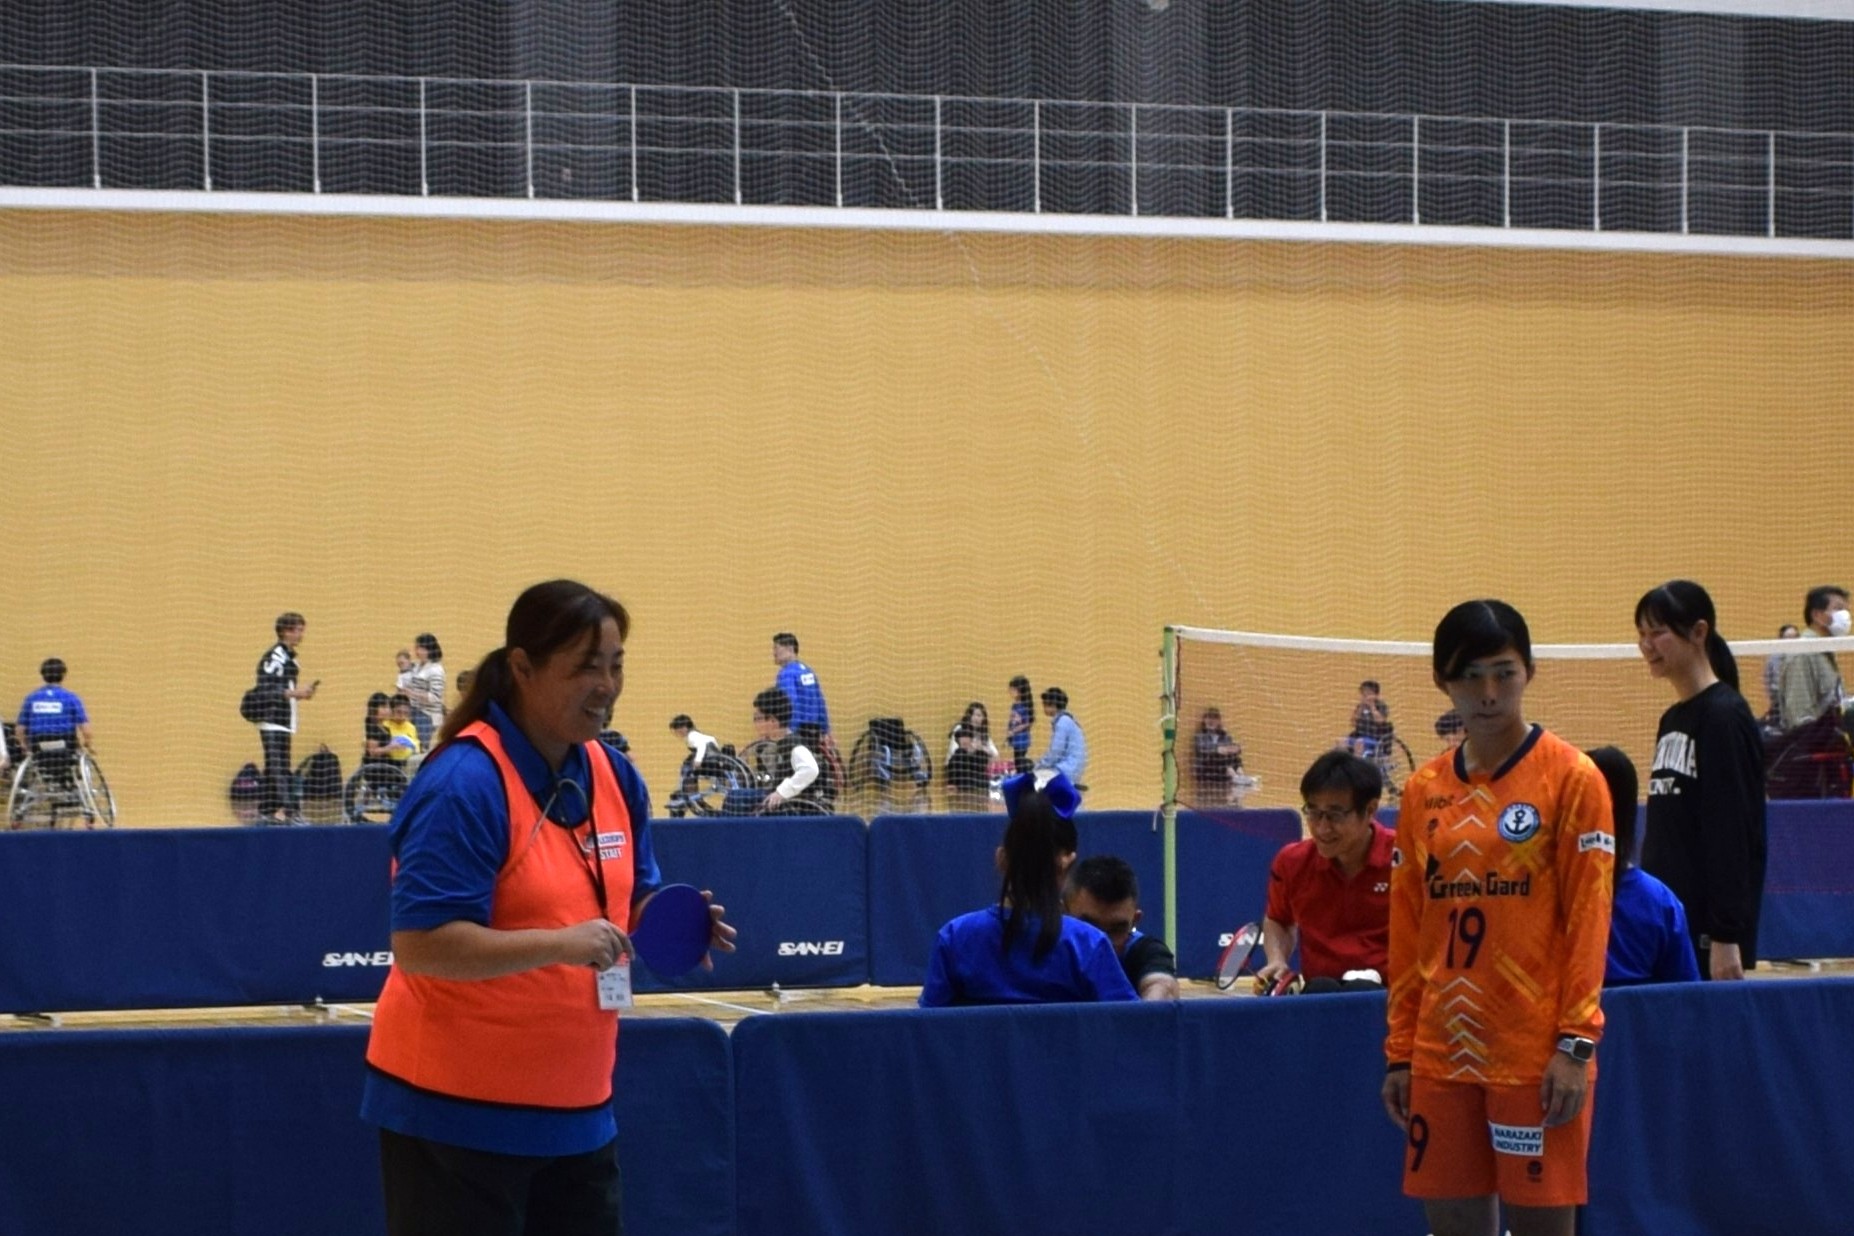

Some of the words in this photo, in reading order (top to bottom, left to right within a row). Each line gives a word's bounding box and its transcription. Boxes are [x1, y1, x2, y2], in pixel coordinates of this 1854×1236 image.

[1486, 872, 1531, 897] Gard
[1446, 905, 1486, 969] 19
[777, 940, 844, 956] SAN-EI
[1494, 1126, 1542, 1141] NARAZAKI
[1495, 1139, 1541, 1153] INDUSTRY
